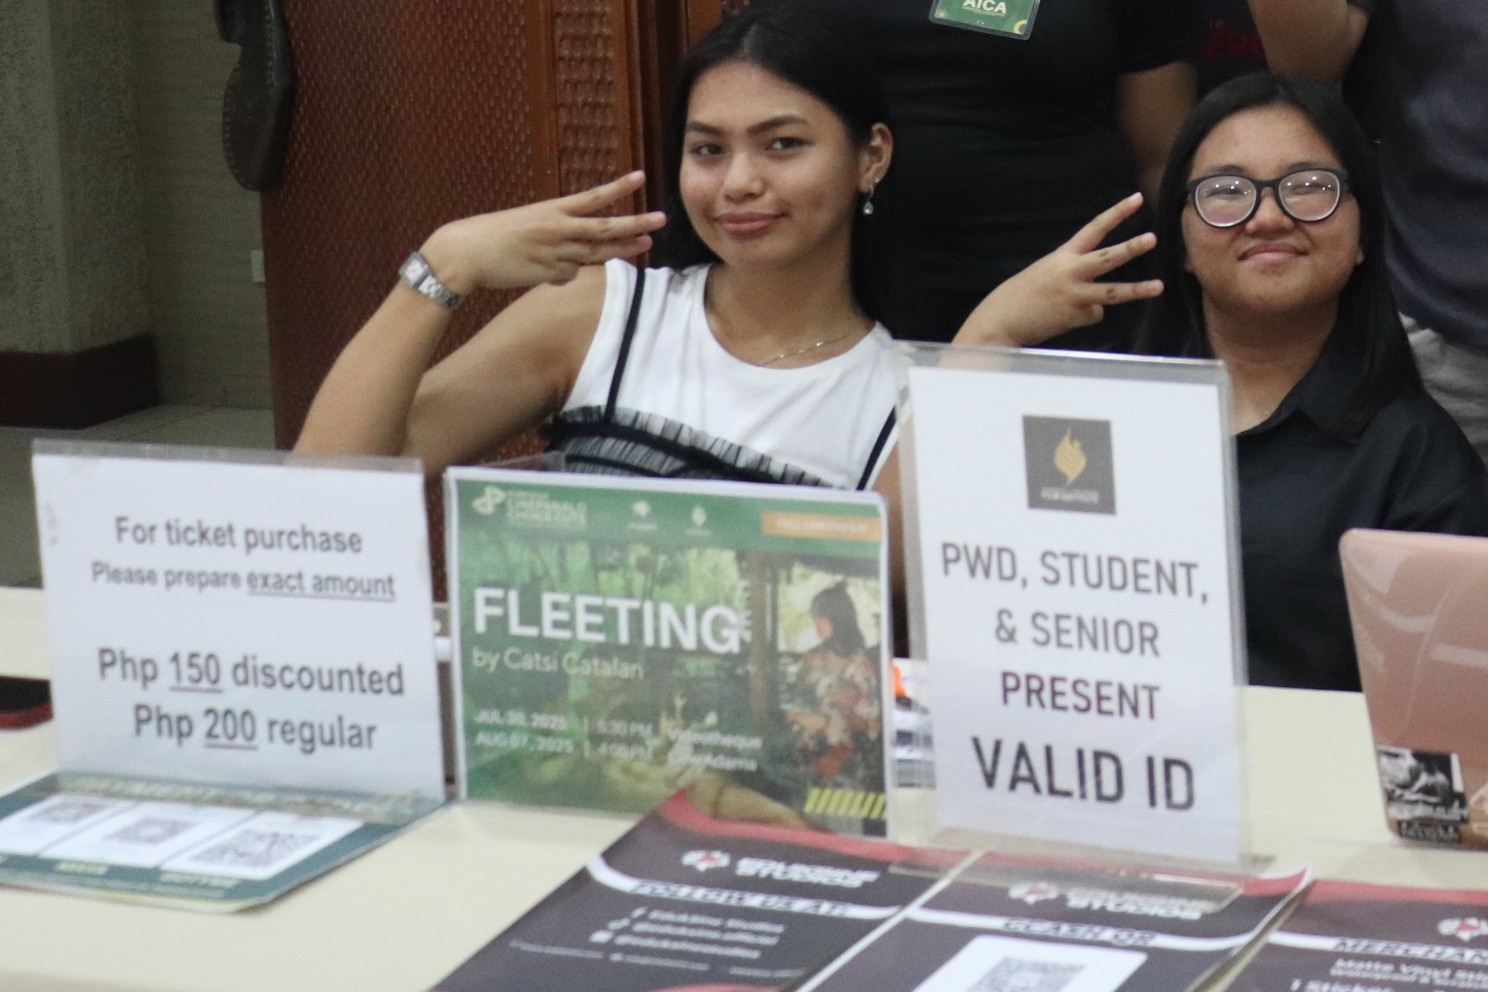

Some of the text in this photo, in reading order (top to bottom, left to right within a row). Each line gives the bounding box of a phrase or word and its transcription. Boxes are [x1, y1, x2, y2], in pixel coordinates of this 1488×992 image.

[116, 516, 363, 555] For ticket purchase
[92, 561, 396, 600] Please prepare exact amount
[942, 542, 1209, 605] PWD, STUDENT,
[473, 586, 742, 656] FLEETING
[995, 608, 1161, 658] & SENIOR
[99, 647, 405, 697] Php 150 discounted
[472, 647, 645, 681] by Catsi Catalan
[1001, 671, 1161, 720] PRESENT
[134, 704, 378, 755] Php 200 regular
[972, 735, 1196, 811] VALID ID
